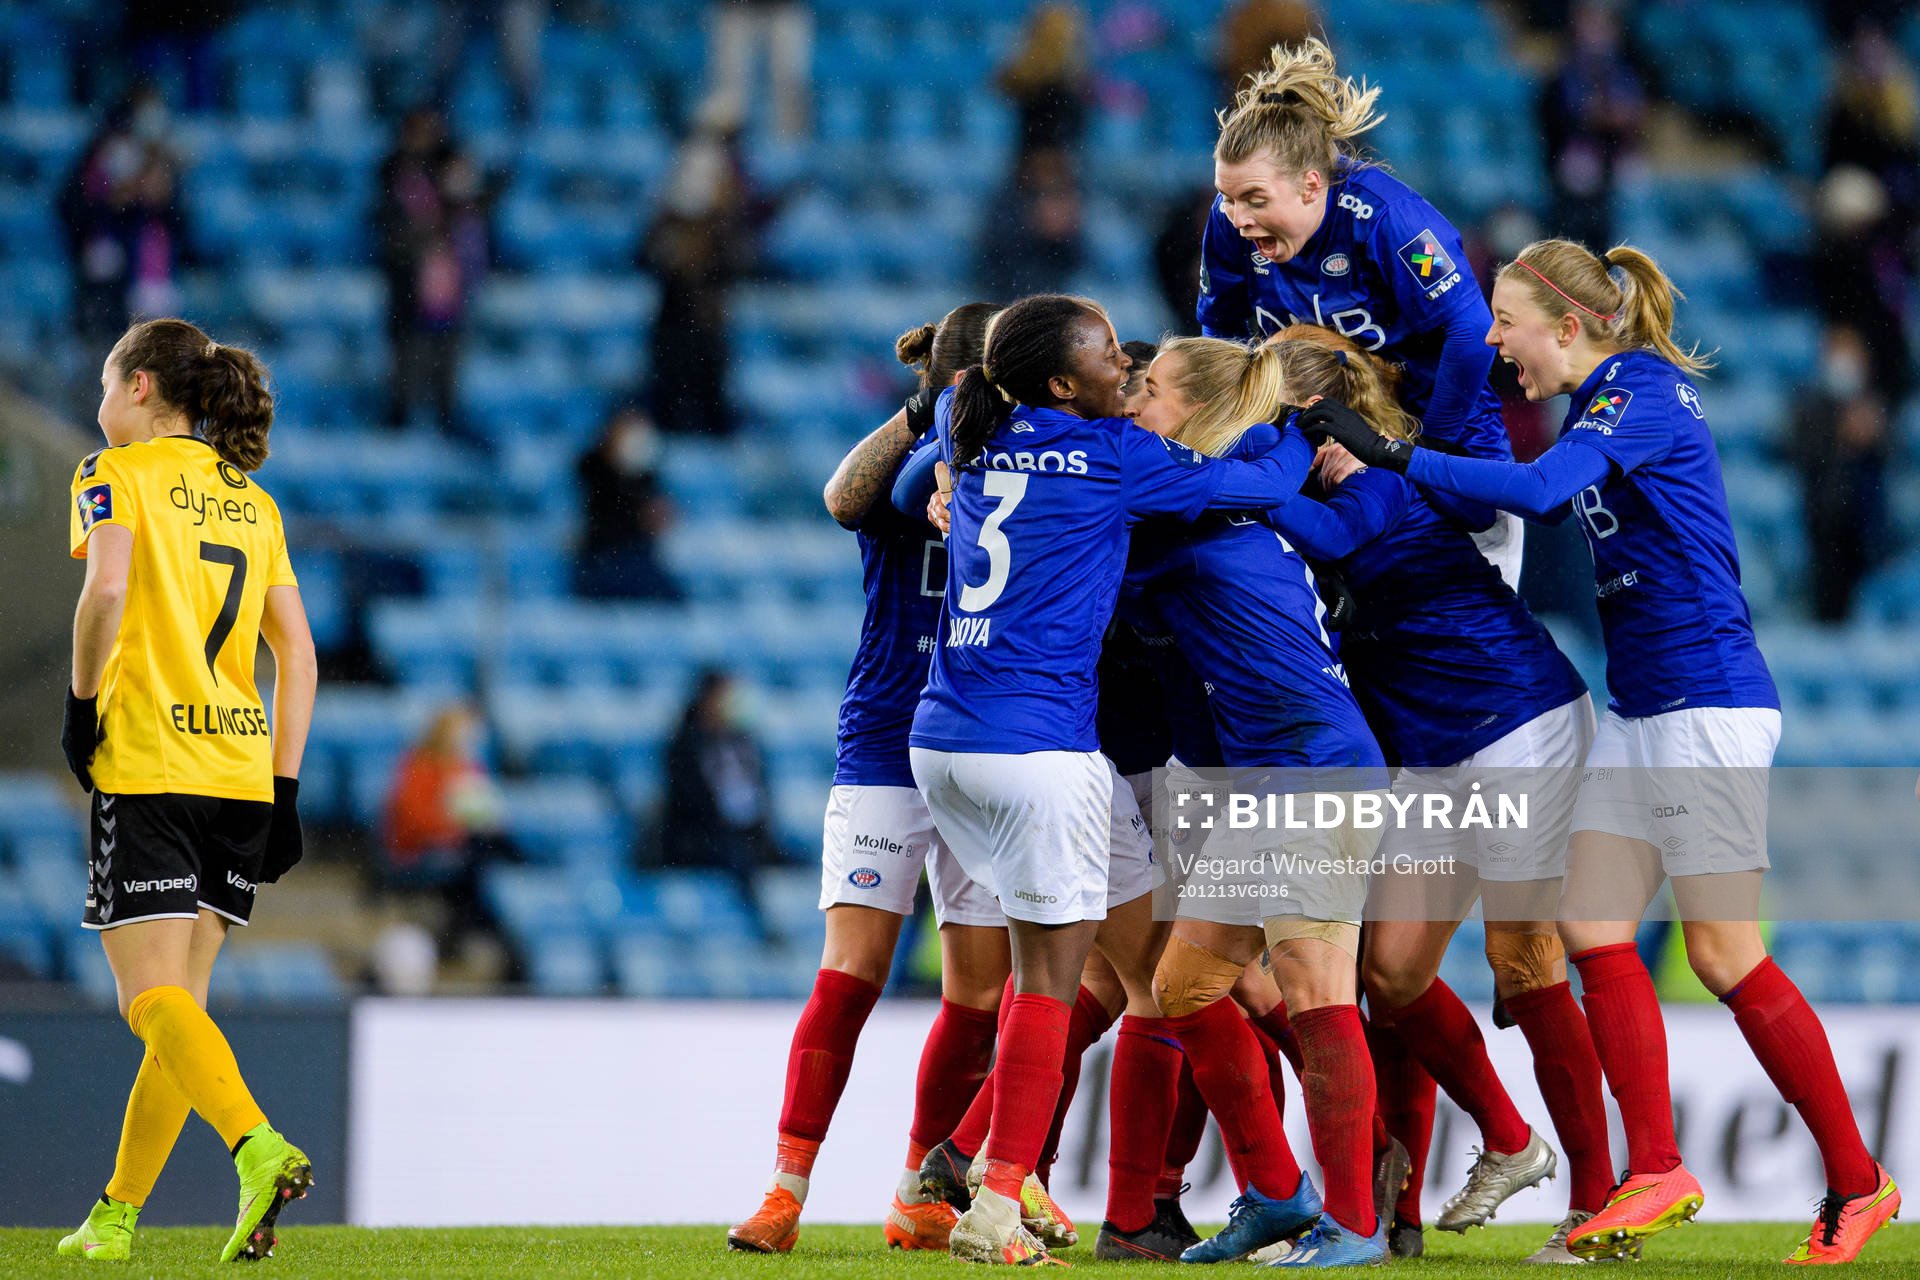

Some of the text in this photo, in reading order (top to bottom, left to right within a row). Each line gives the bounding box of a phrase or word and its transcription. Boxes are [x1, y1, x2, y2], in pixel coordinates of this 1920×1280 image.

[1426, 272, 1461, 301] umbro
[958, 470, 1030, 613] 3
[199, 540, 248, 688] 7
[171, 703, 271, 736] ELLINGSE
[226, 870, 257, 895] Van
[1014, 888, 1058, 904] umbro
